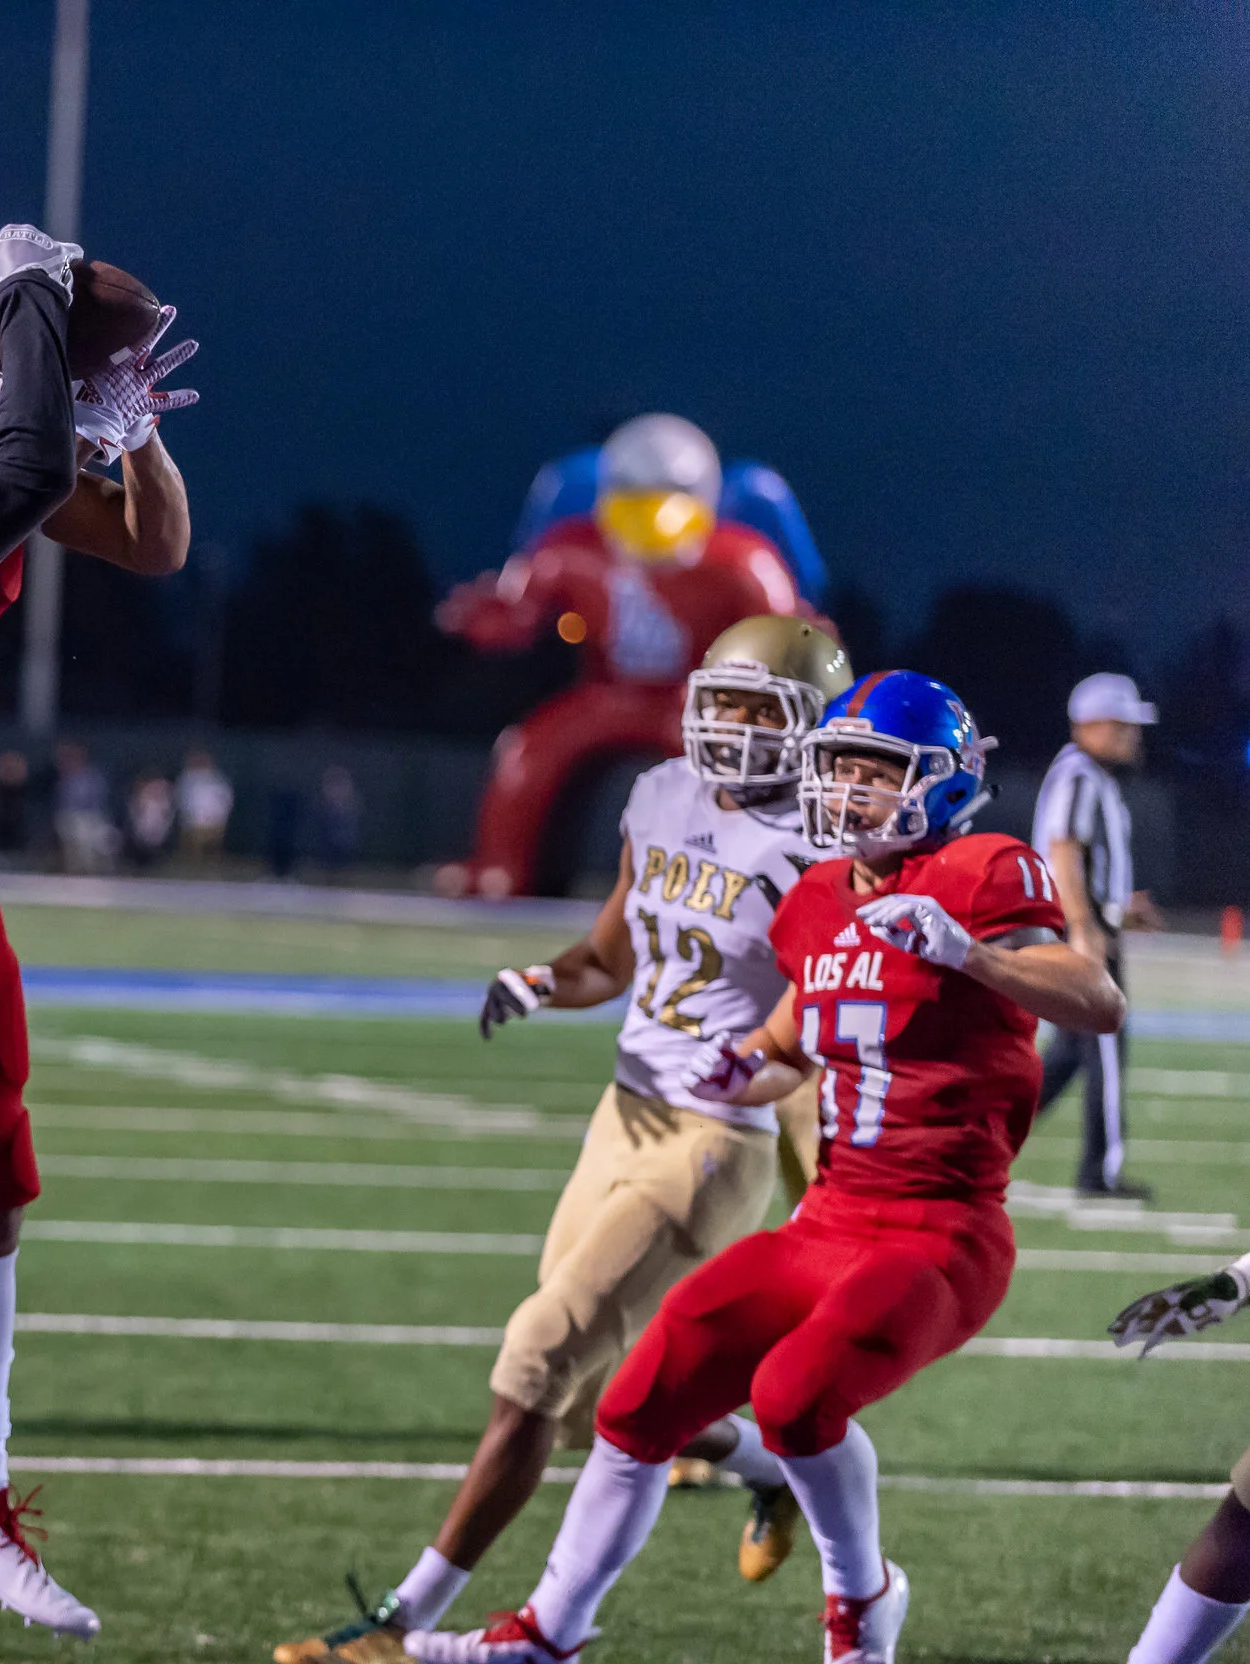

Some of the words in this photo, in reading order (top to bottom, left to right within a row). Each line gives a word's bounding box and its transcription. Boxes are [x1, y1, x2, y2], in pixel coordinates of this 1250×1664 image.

[638, 846, 751, 922] POLY
[637, 907, 723, 1041] 12
[804, 952, 848, 993] LOS
[846, 951, 884, 992] AL
[800, 999, 893, 1147] 17
